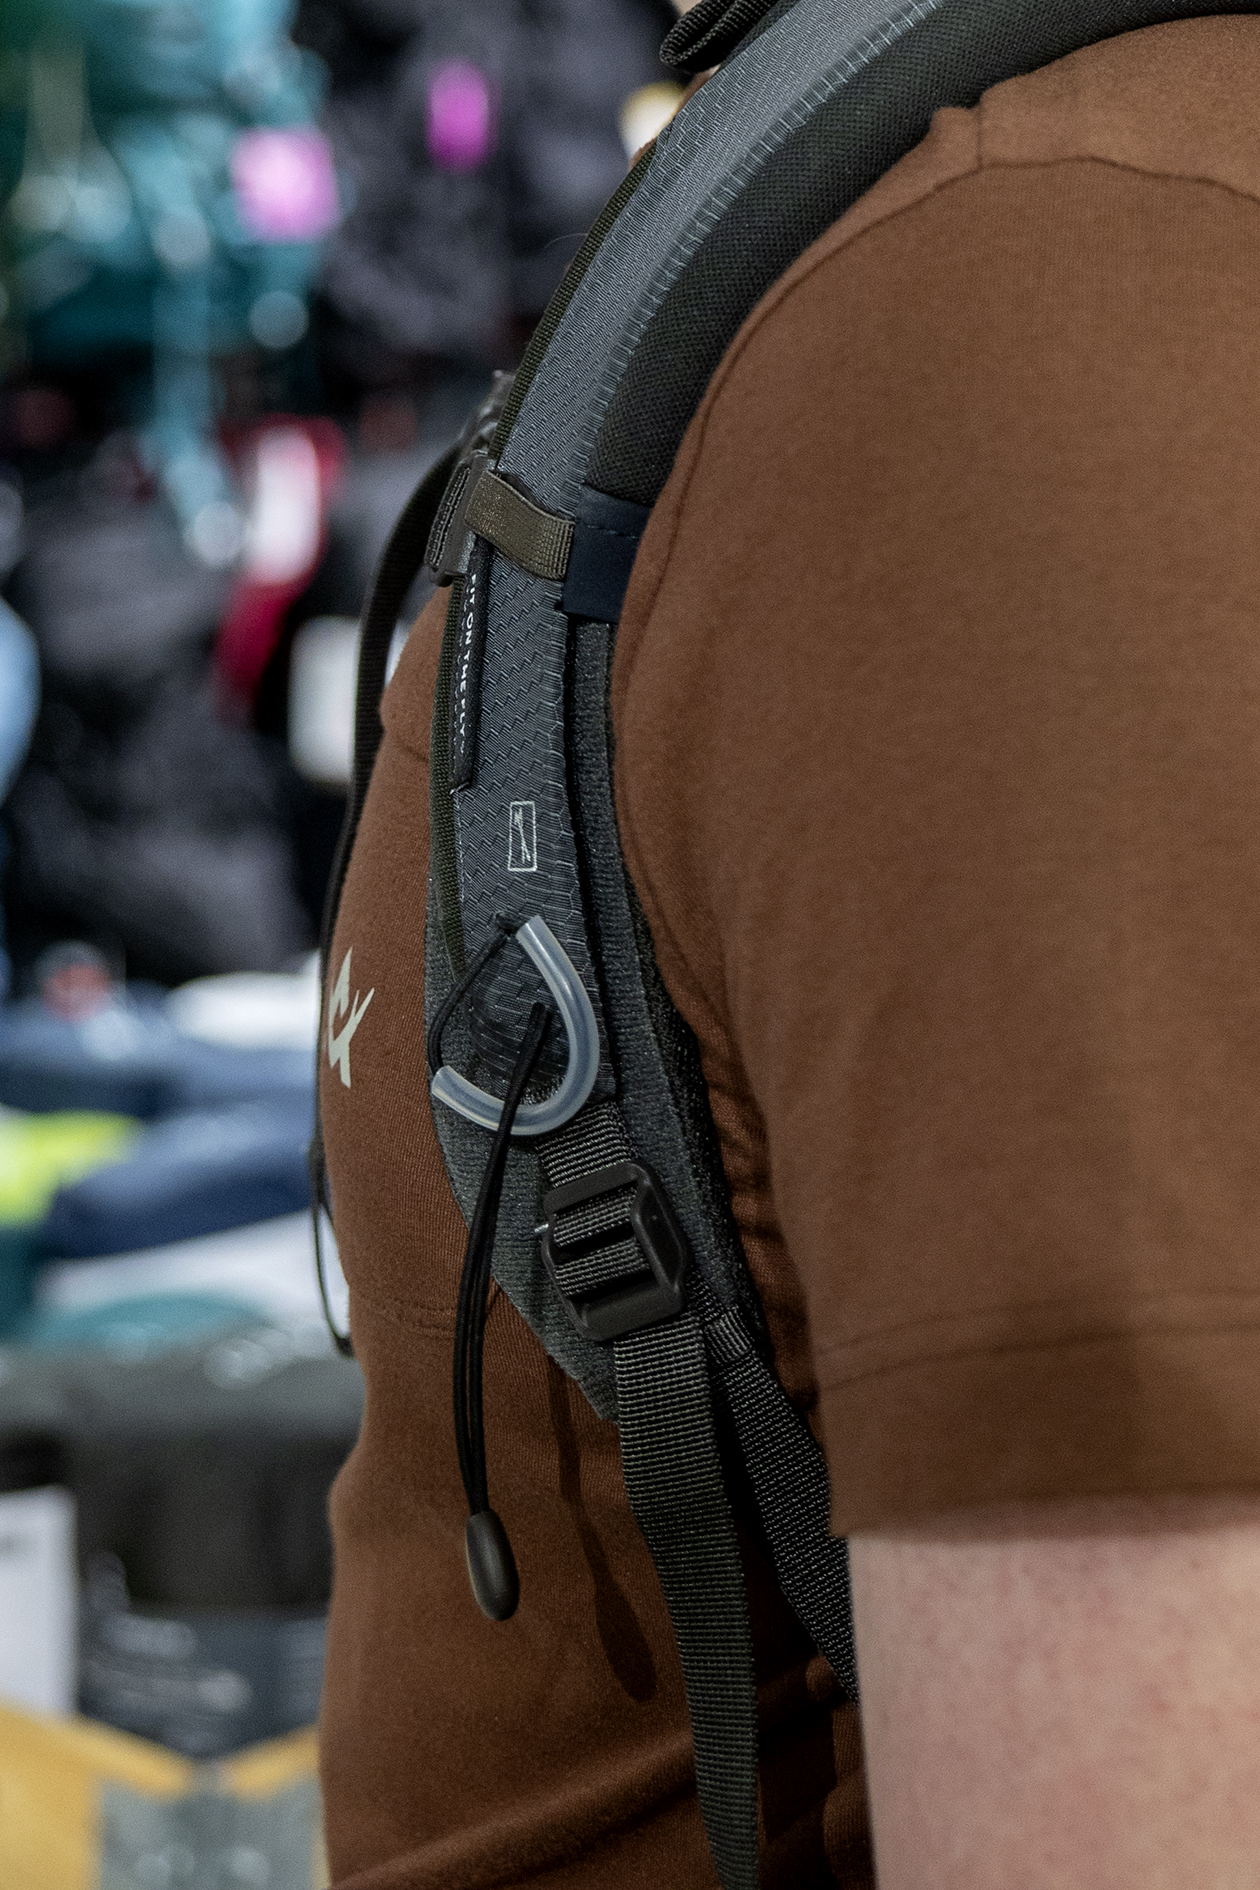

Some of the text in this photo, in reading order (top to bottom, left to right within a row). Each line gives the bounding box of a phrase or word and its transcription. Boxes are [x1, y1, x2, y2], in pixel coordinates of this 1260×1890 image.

[469, 574, 477, 604] FIT
[465, 612, 474, 645] ON
[460, 650, 470, 693] THE
